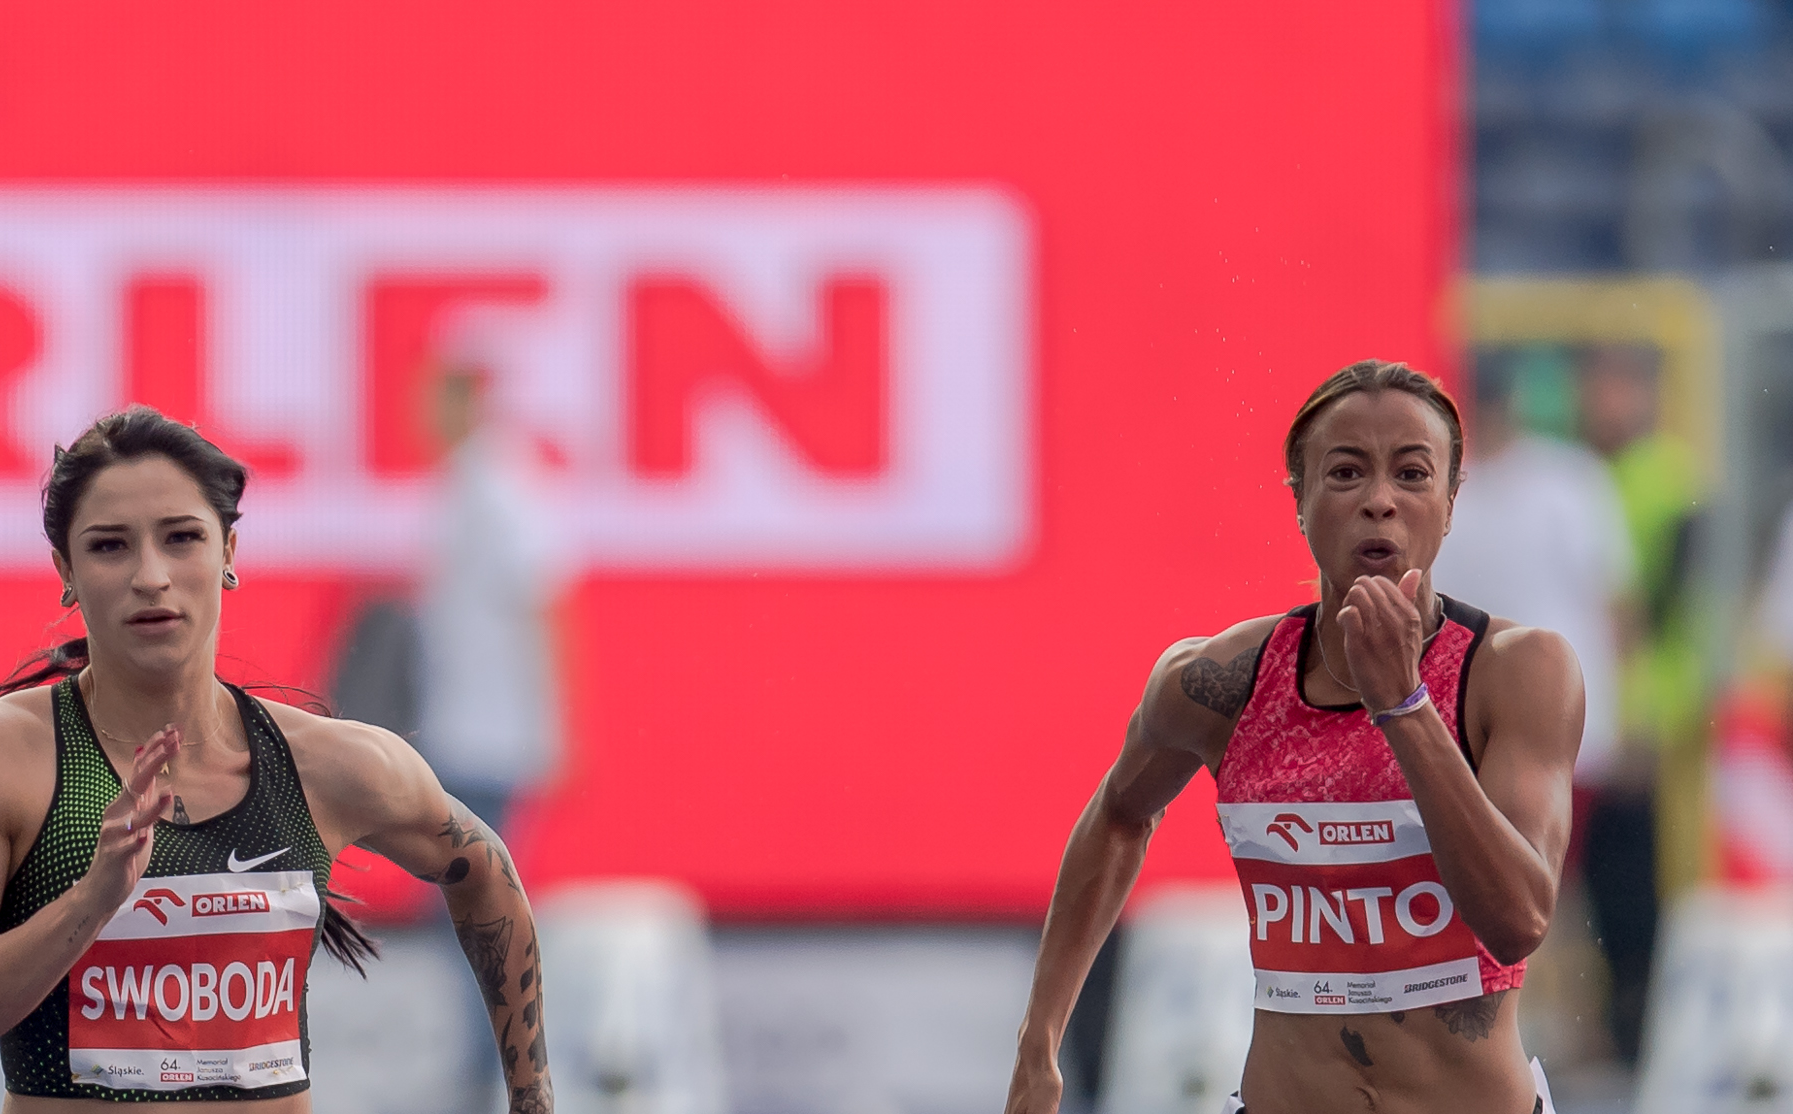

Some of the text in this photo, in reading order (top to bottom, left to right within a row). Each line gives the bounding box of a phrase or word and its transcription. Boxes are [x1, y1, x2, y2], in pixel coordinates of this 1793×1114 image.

[1322, 822, 1390, 843] ORLEN
[195, 893, 267, 913] ORLEN
[1251, 880, 1455, 945] PINTO
[80, 957, 295, 1022] SWOBODA
[1403, 973, 1468, 994] BRIDGESTONE
[1316, 996, 1345, 1004] ORLEN
[248, 1056, 295, 1072] BRIDGESTONE
[161, 1073, 194, 1082] ORLEN
